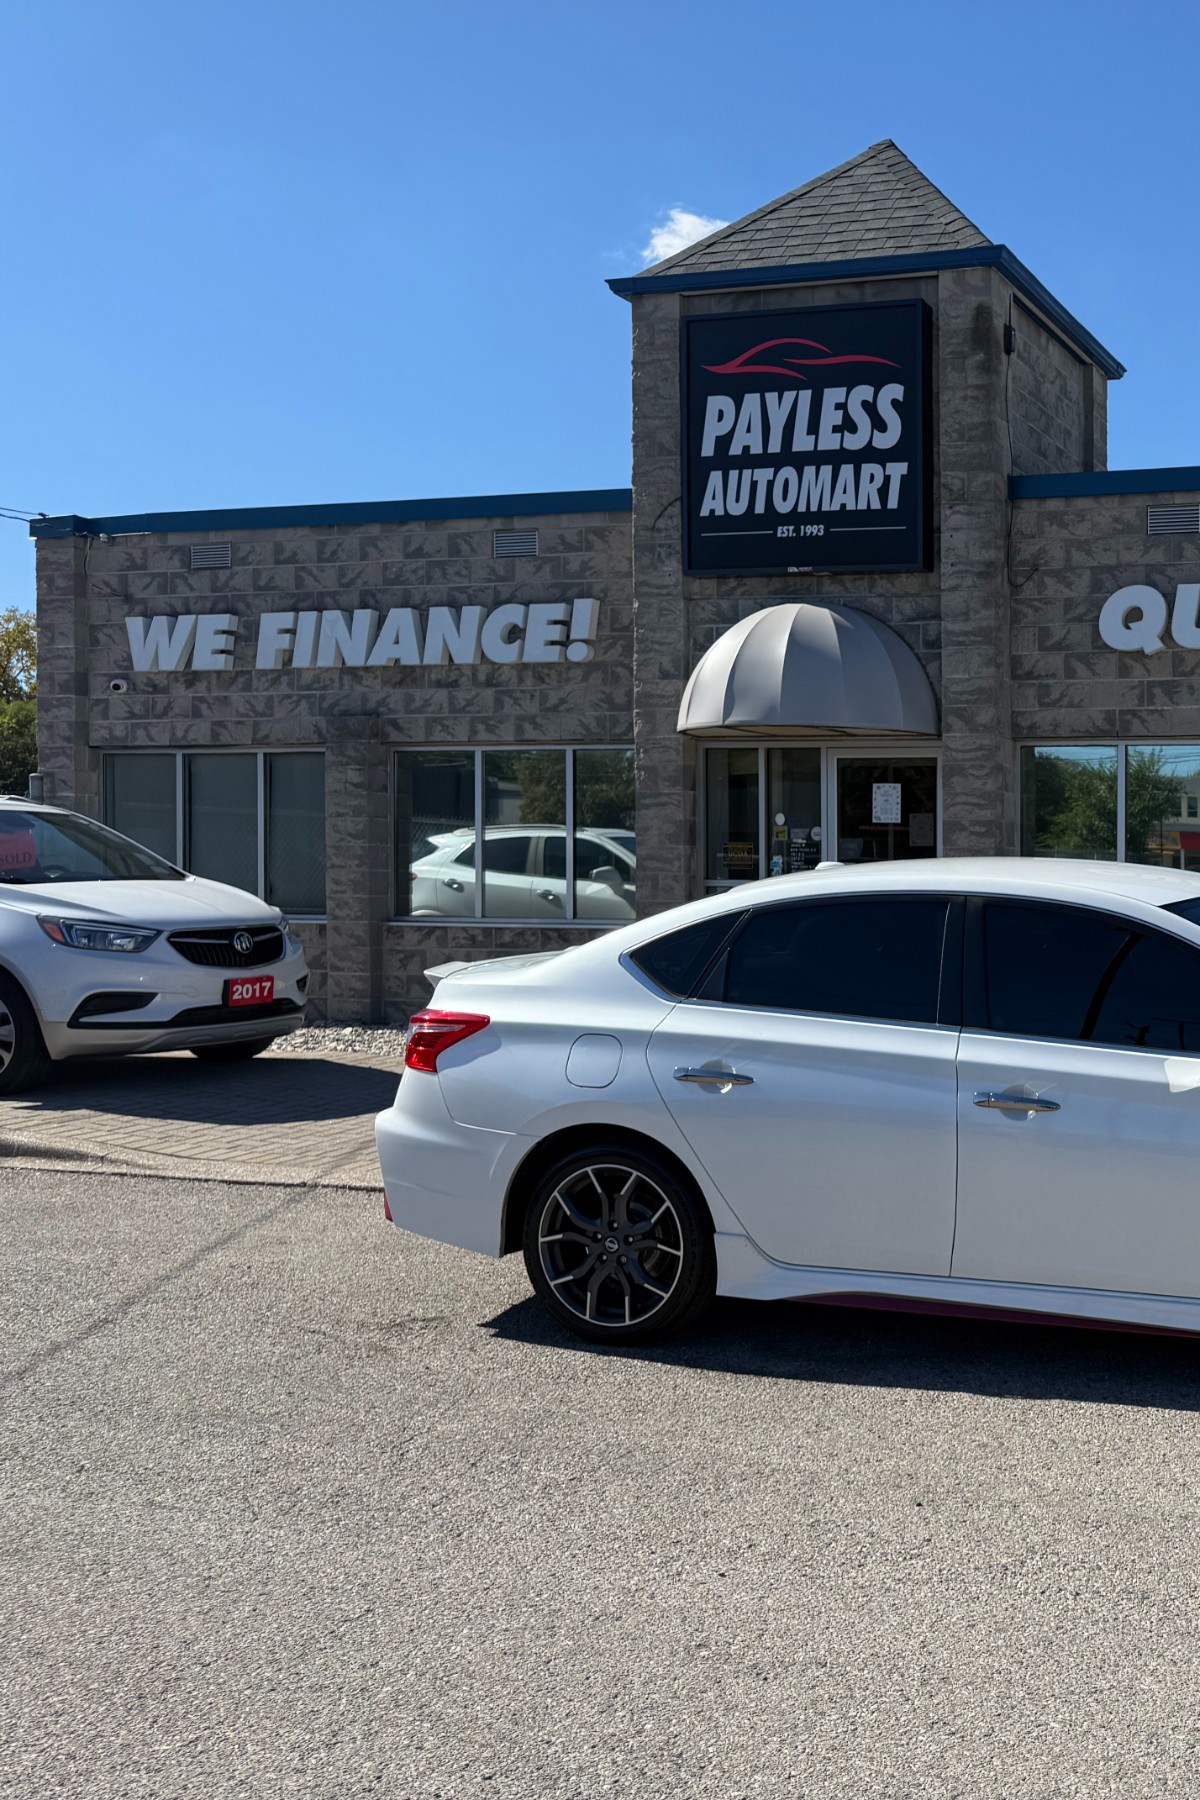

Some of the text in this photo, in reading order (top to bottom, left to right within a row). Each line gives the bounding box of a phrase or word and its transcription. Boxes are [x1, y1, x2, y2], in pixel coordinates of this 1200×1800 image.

[701, 383, 905, 457] PAYLESS
[699, 462, 908, 517] AUTOMART
[776, 525, 825, 537] EST. 1993
[124, 598, 599, 672] WE FINANCE!
[232, 981, 272, 1000] 2017
